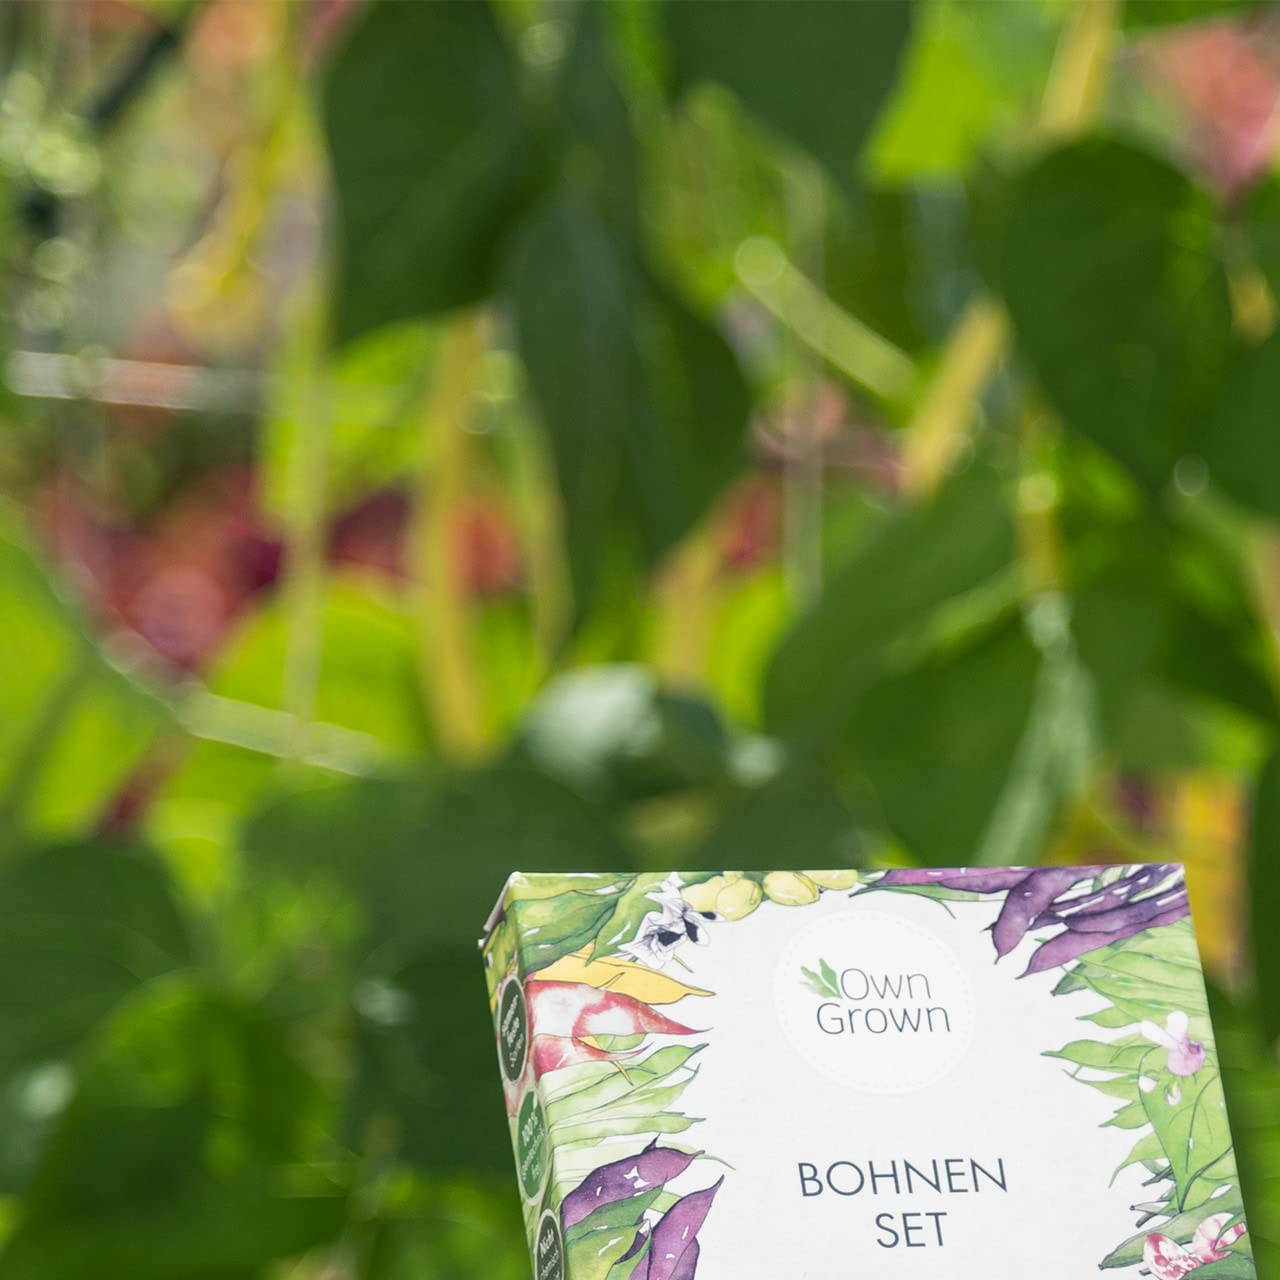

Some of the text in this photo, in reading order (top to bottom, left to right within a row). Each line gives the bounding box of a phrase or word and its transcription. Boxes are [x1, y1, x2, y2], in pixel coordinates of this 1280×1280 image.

[840, 967, 931, 1001] Own
[816, 1002, 951, 1036] Grown
[798, 1158, 1009, 1198] BOHNEN
[874, 1212, 948, 1249] SET
